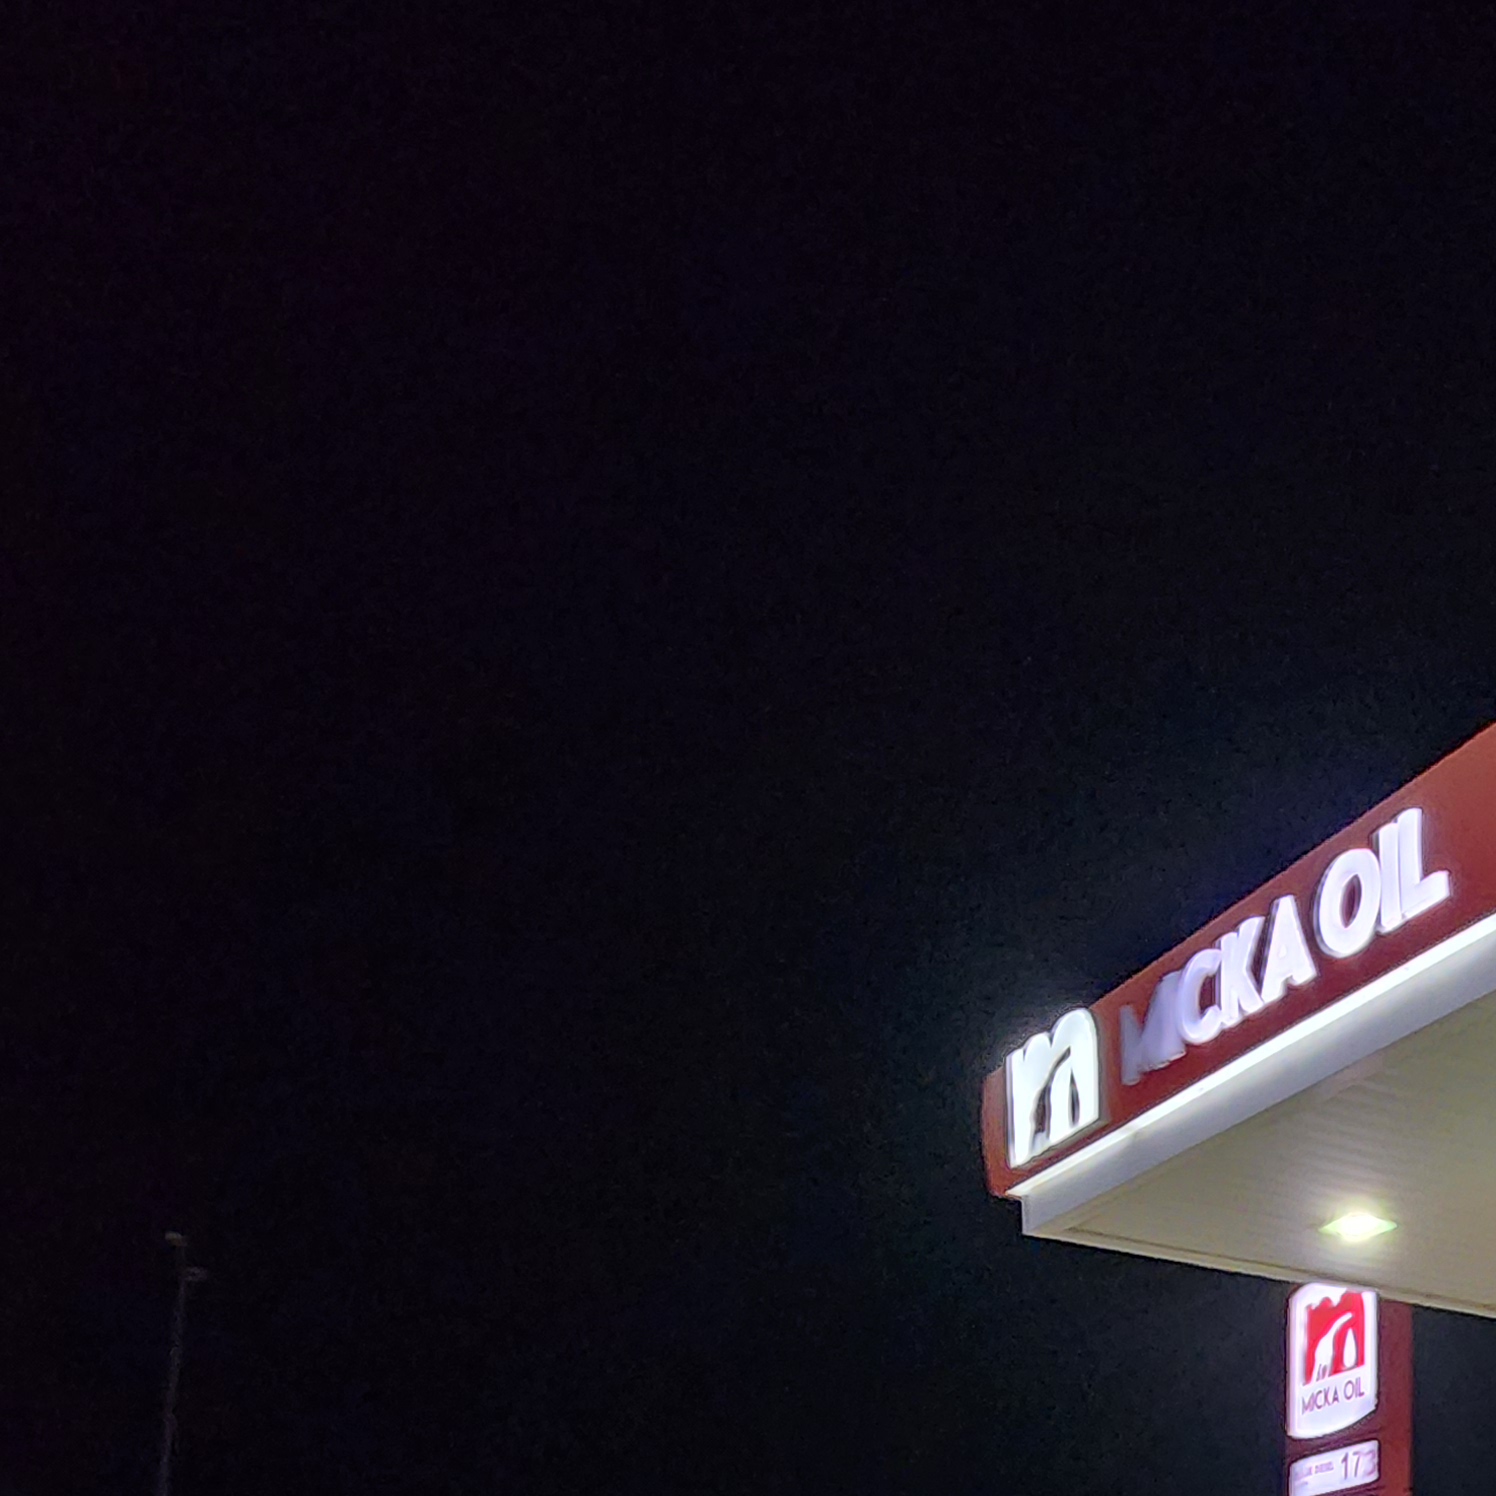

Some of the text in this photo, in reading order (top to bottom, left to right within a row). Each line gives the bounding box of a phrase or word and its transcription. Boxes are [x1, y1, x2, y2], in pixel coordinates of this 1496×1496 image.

[1313, 807, 1452, 958] OIL
[1301, 1377, 1365, 1415] MICKA OIL
